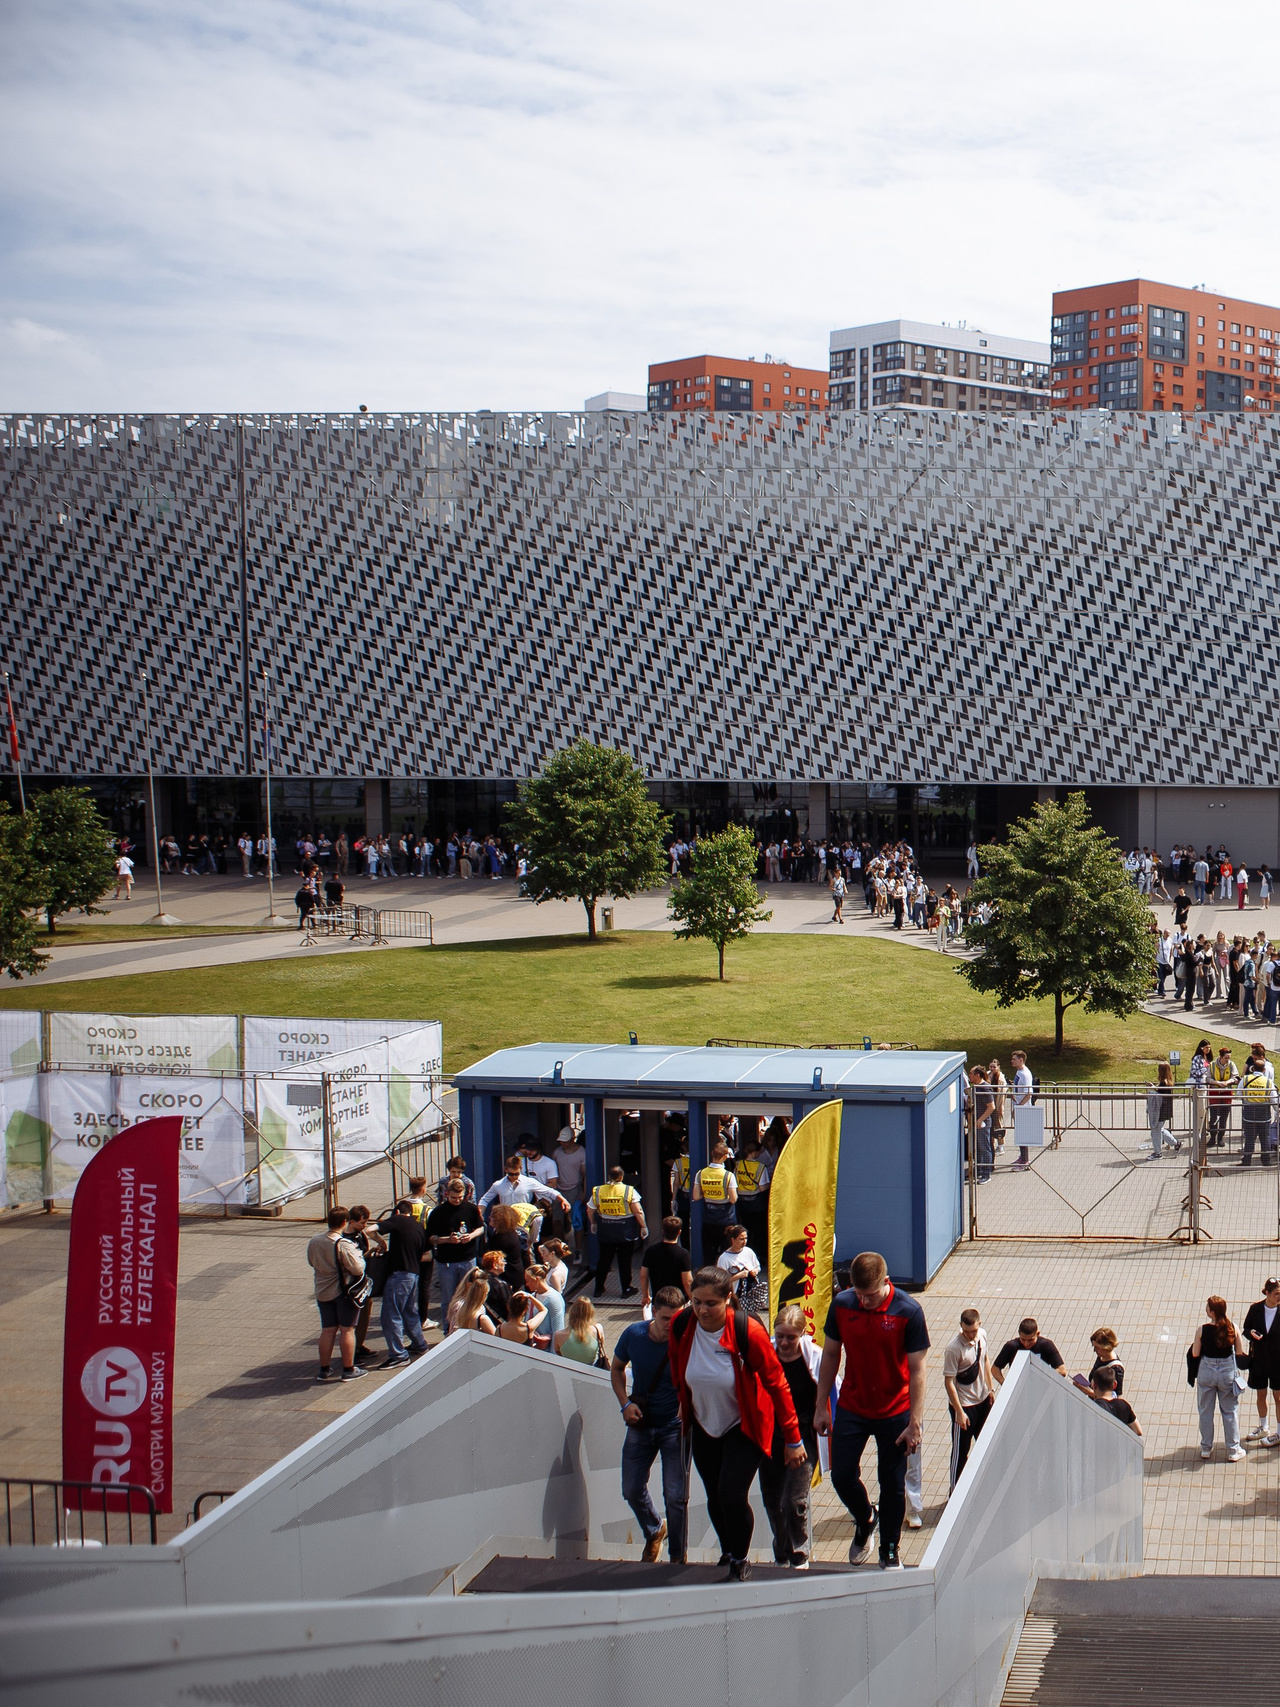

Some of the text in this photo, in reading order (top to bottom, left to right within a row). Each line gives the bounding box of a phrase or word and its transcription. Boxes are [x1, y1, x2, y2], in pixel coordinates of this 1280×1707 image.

[139, 1093, 203, 1108] СКОРО
[332, 1063, 367, 1084] СКОРО
[73, 1112, 130, 1128] ЗДЕСЬ
[299, 1102, 369, 1137] КОМОРТНЕЕ
[98, 1234, 114, 1324] РУССКИЙ
[117, 1167, 135, 1325] МУЗЫКАЛЬНЫЙ
[137, 1183, 157, 1326] ТЕЛЕКАНАЛ
[91, 1359, 132, 1494] RU TV
[150, 1351, 166, 1494] СМОТРИ МУЗЫКУ!
